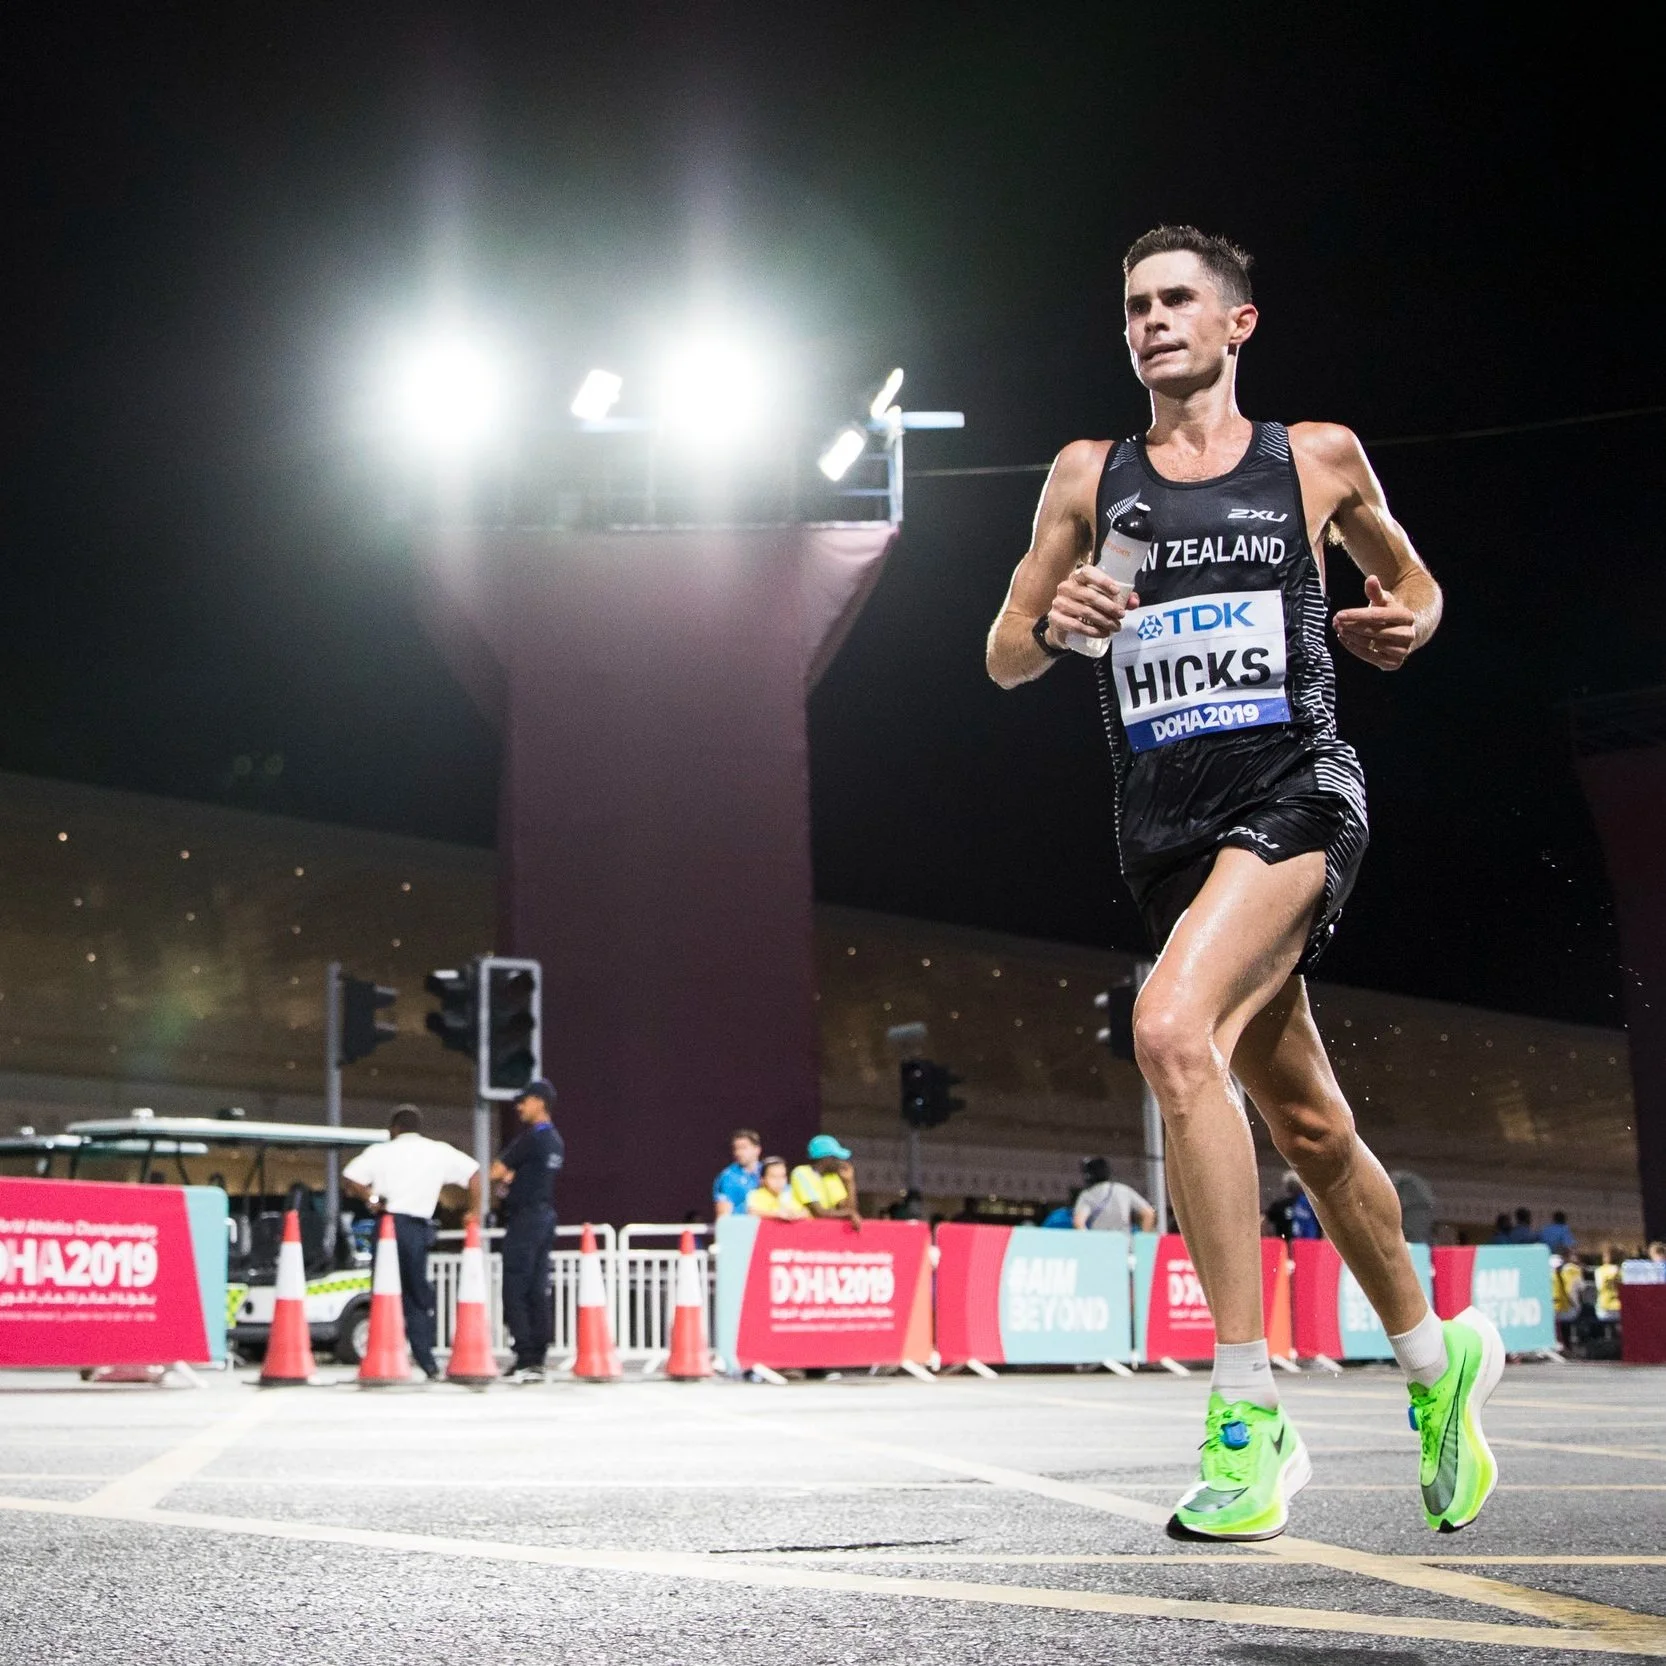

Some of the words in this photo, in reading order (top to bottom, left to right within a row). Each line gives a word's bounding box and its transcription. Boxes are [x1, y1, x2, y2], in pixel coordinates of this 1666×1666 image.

[1227, 508, 1288, 523] 2XU
[1166, 535, 1285, 569] ZEALAND
[1162, 601, 1255, 635] TDK
[1125, 647, 1271, 709] HICKS
[1151, 703, 1259, 742] DOHA2019
[769, 1265, 895, 1304] DOHA2019
